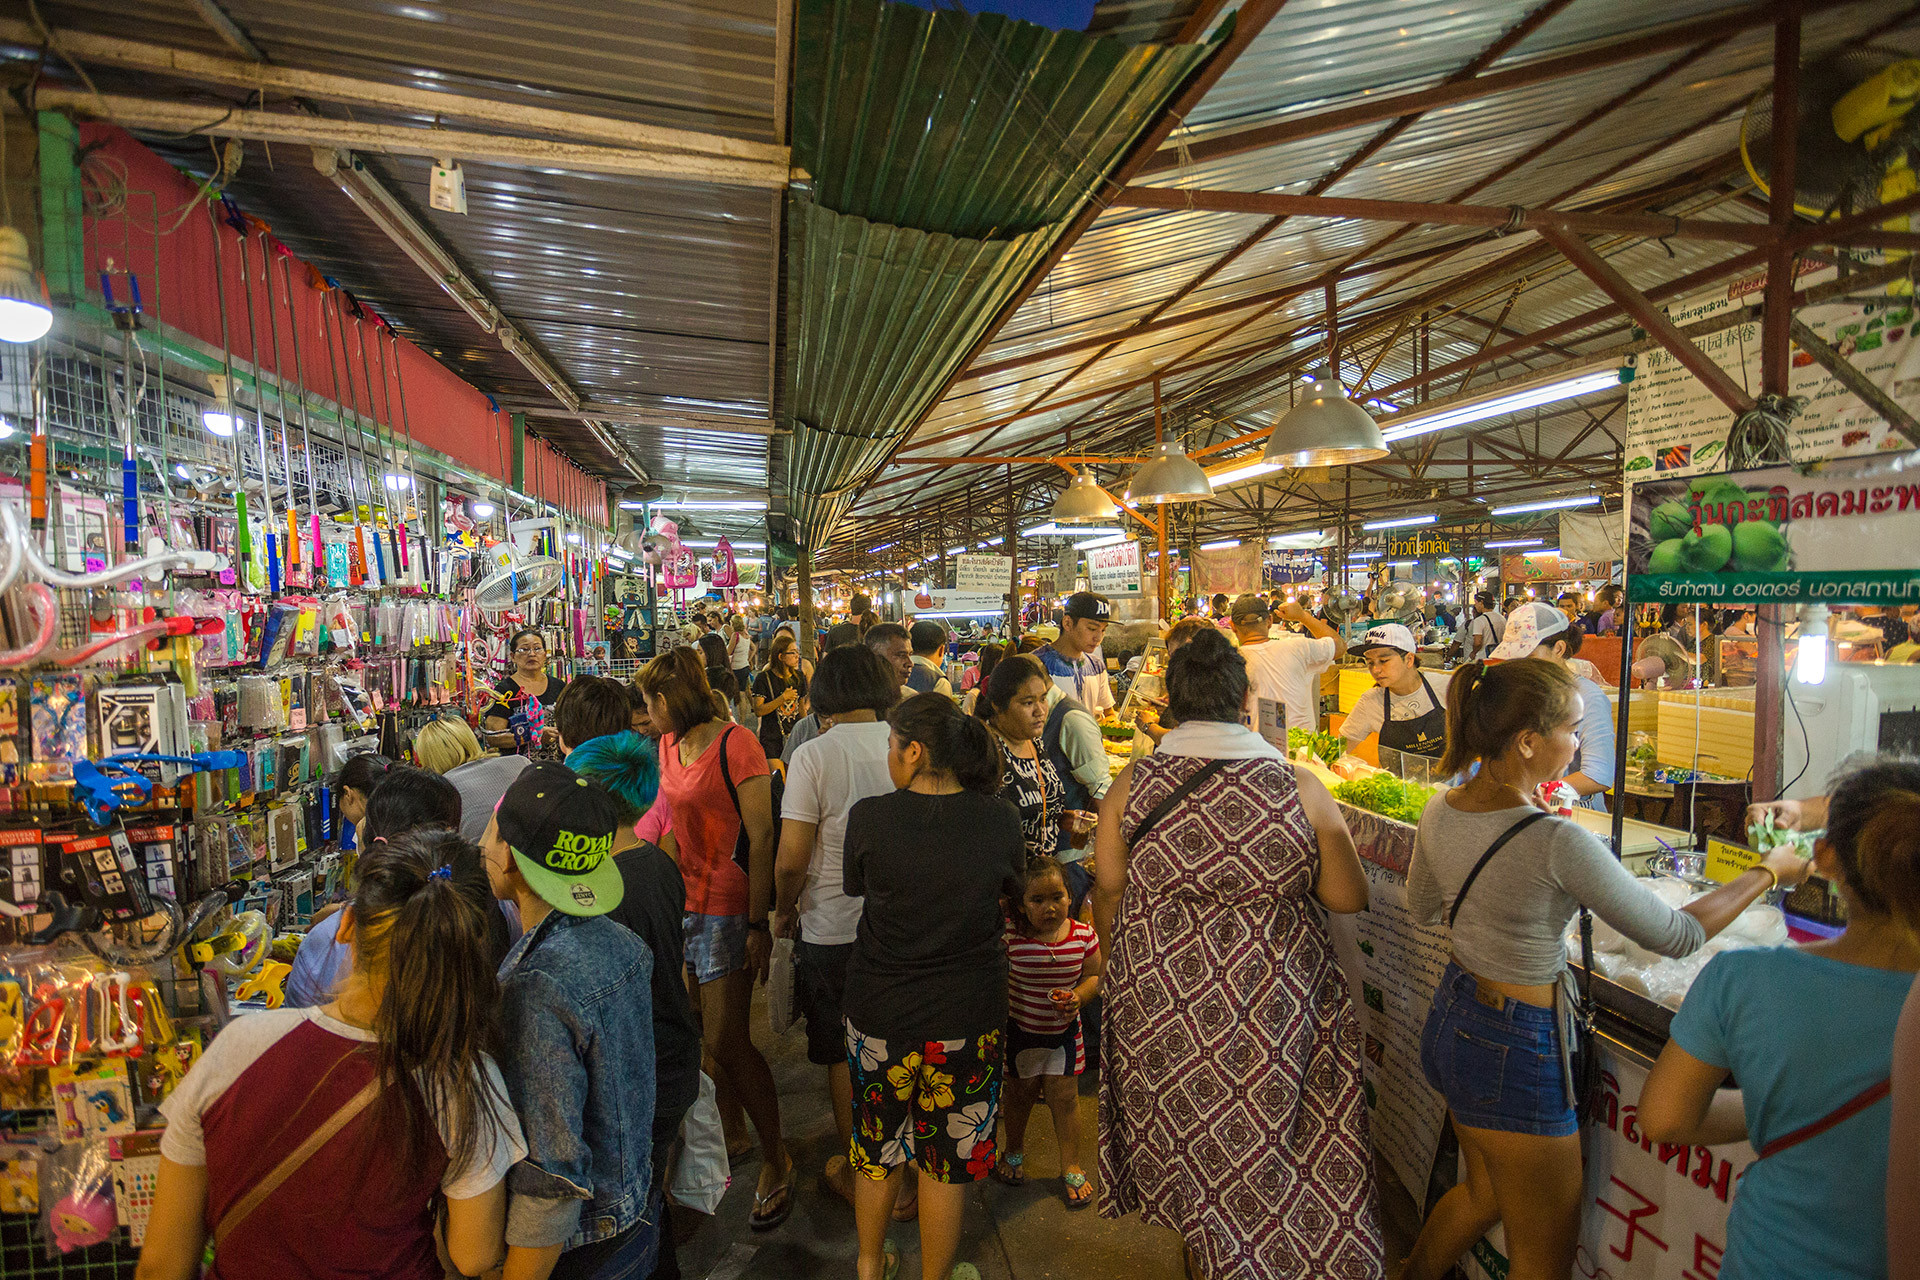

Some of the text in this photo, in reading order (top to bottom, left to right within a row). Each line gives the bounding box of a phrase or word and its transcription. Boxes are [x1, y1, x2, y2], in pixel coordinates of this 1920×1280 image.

[1648, 325, 1756, 369] 清新田园春卷
[1865, 362, 1896, 374] Dressing
[1796, 380, 1819, 391] Choose
[1804, 412, 1821, 421] Extra
[1813, 439, 1835, 448] Bacon
[1389, 534, 1451, 556] ข้าวเปียกเส้น
[1659, 580, 1725, 598] รับทำตาม
[1733, 578, 1801, 597] ออเดอร์
[0, 831, 37, 840] UNIVERSAL
[131, 827, 169, 836] UNIVERSAL
[553, 830, 613, 854] ROYAL
